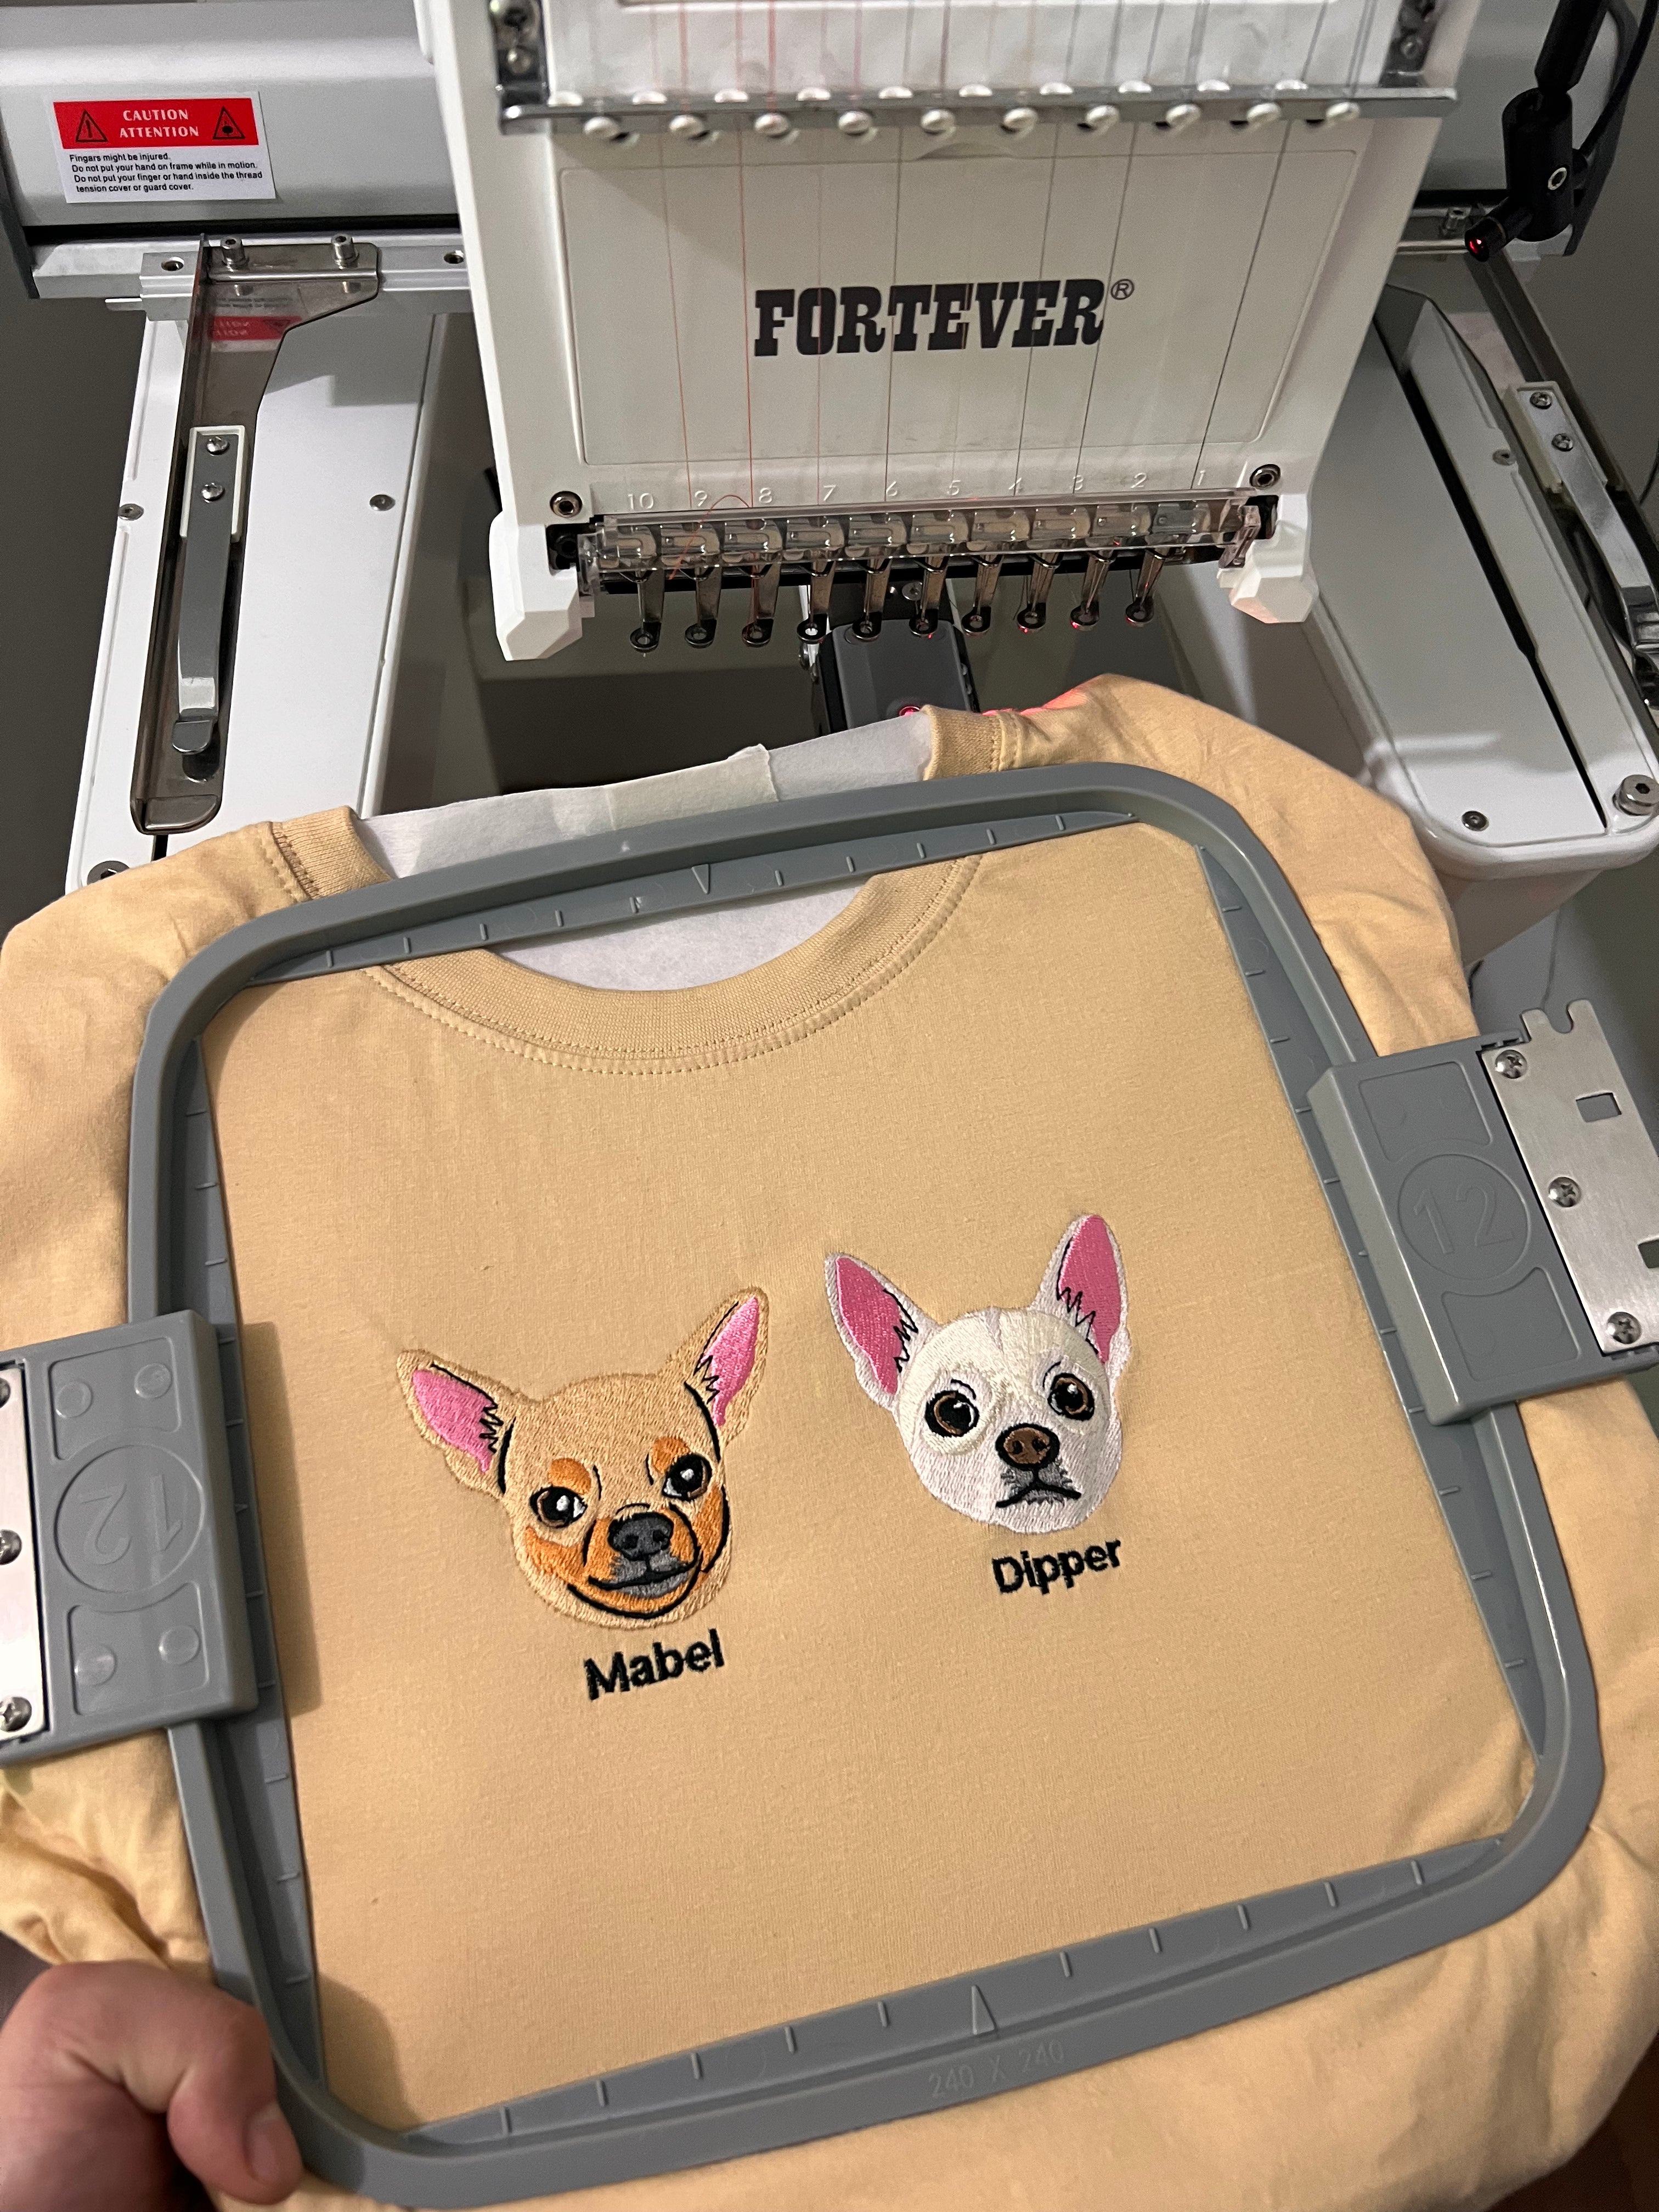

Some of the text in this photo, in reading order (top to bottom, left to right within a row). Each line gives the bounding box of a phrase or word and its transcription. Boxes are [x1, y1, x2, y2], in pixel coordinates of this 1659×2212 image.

[123, 109, 189, 121] CAUTION
[120, 126, 199, 138] ATTENTION
[101, 164, 114, 173] put
[115, 165, 133, 173] your
[103, 154, 127, 162] might
[103, 174, 116, 183] put
[117, 174, 135, 183] your
[137, 173, 160, 183] finger
[143, 183, 167, 193] guard
[628, 492, 654, 510] 10
[694, 490, 708, 507] 9
[759, 487, 772, 504] 8
[823, 484, 836, 501] 7
[885, 481, 898, 496] 6
[947, 479, 961, 495] 5
[1070, 475, 1084, 490] 3
[1130, 472, 1147, 488] 2
[1197, 470, 1206, 486] 1
[1413, 1182, 1516, 1256] 12
[78, 1474, 184, 1566] 12
[991, 1539, 1121, 1596] Dipper
[583, 1628, 725, 1701] Mabel
[928, 2065, 974, 2099] 240
